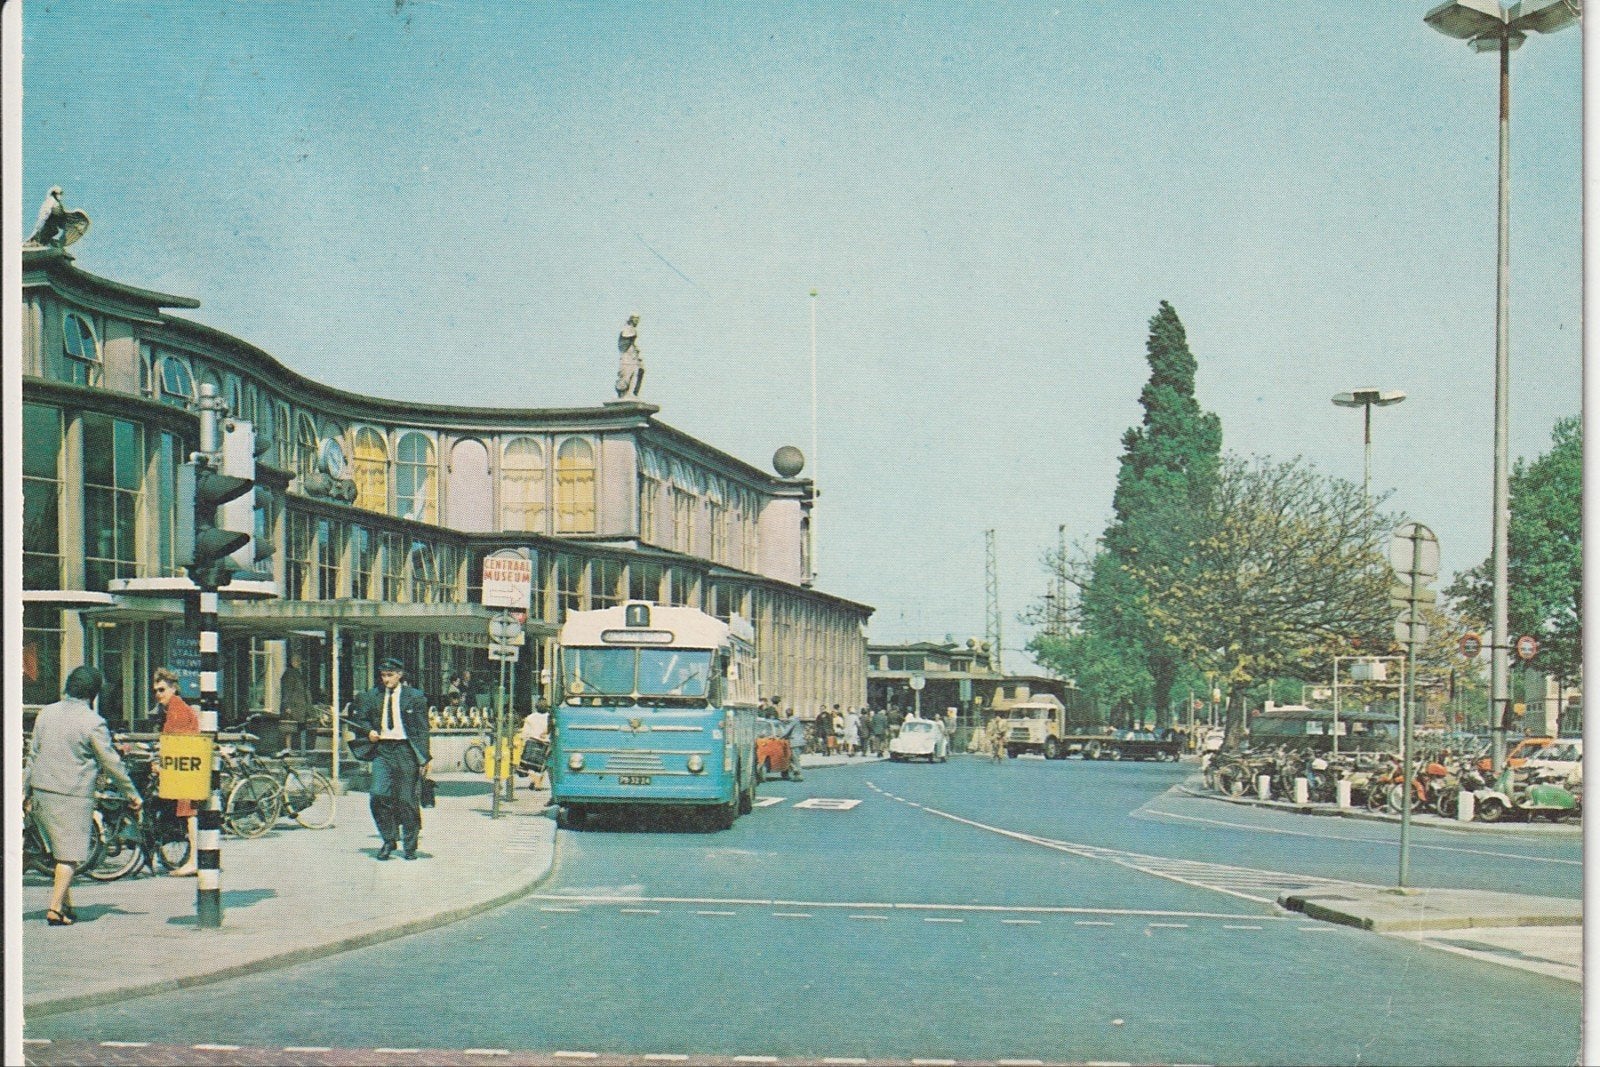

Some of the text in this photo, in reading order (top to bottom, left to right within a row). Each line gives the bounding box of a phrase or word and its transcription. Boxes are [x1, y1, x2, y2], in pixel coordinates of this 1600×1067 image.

[484, 559, 530, 572] CENTRAAL
[484, 569, 530, 583] MUSEUM
[634, 606, 642, 623] 1
